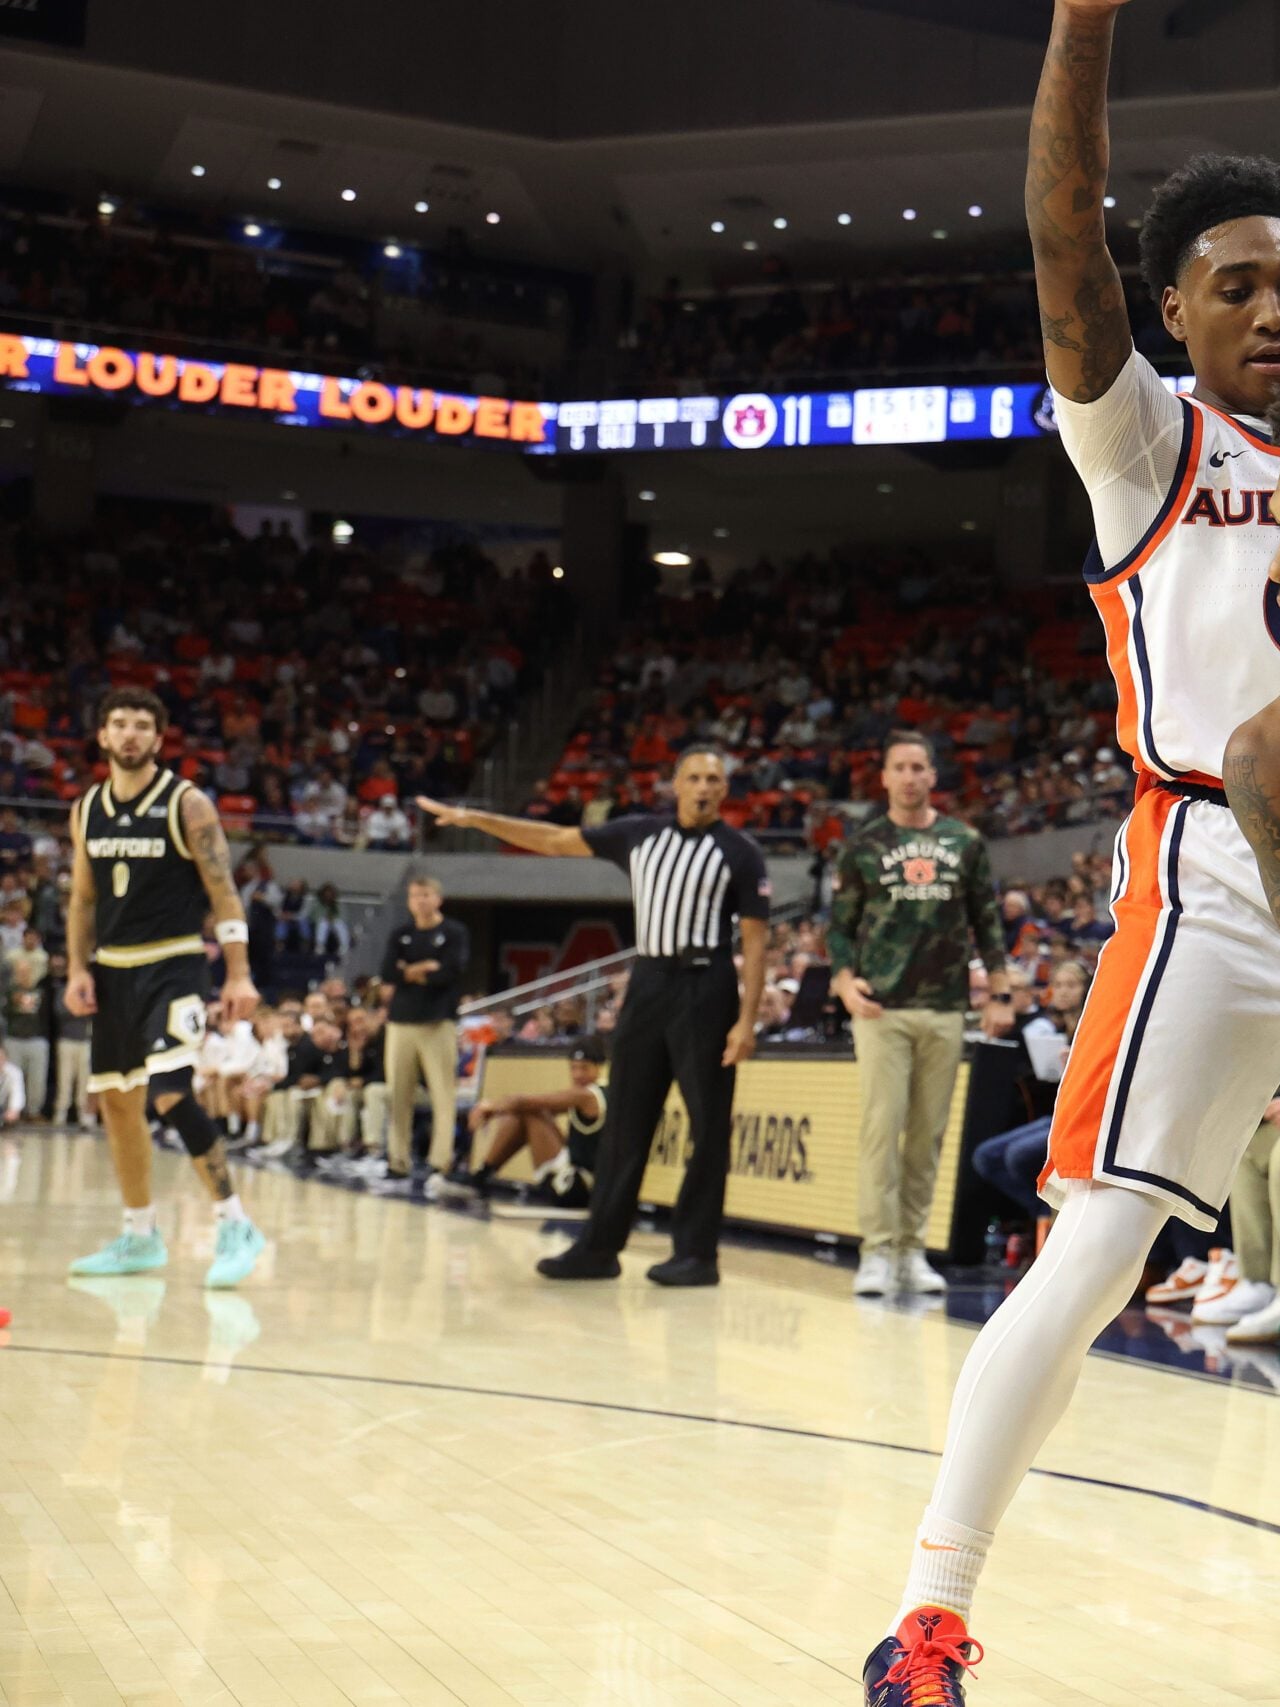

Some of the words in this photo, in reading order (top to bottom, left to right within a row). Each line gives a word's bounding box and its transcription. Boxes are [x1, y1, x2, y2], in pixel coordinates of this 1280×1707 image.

[54, 341, 297, 413] LOUDER
[319, 376, 546, 443] LOUDER
[782, 395, 812, 446] 11
[990, 387, 1013, 438] 6
[86, 837, 166, 858] WOFFORD
[881, 842, 960, 870] AUBURN
[112, 861, 130, 898] 0
[887, 883, 952, 901] TIGERS
